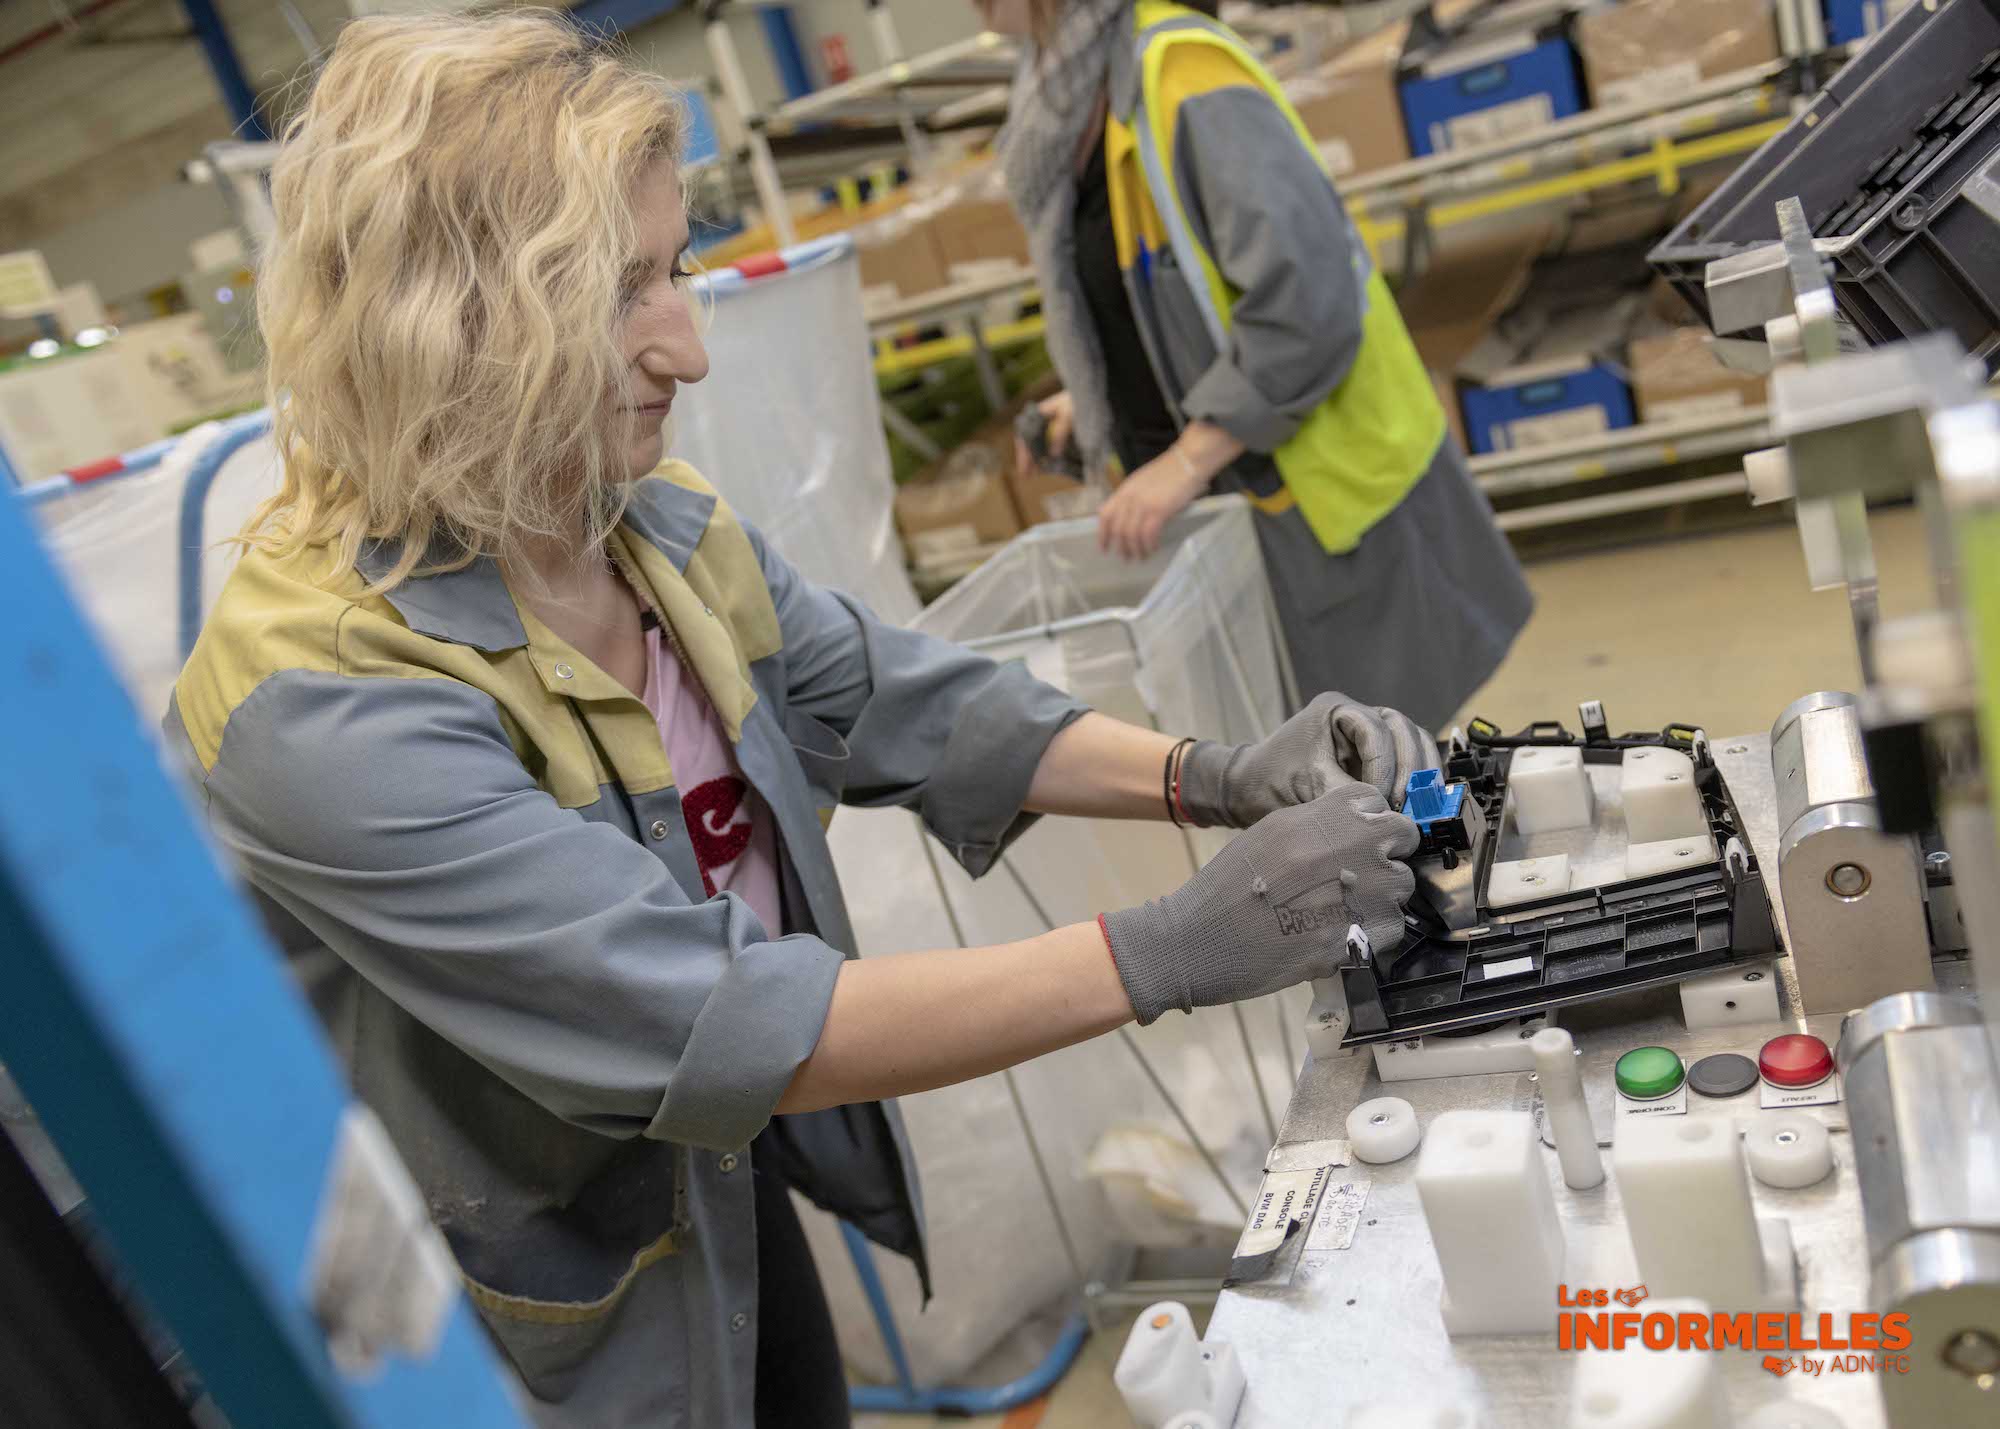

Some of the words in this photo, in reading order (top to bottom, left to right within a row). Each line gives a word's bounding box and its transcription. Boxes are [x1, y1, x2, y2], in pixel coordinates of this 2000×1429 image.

[1260, 1192, 1274, 1212] BVM
[1275, 1190, 1295, 1230] CONSOLE
[1253, 1212, 1267, 1230] DAG
